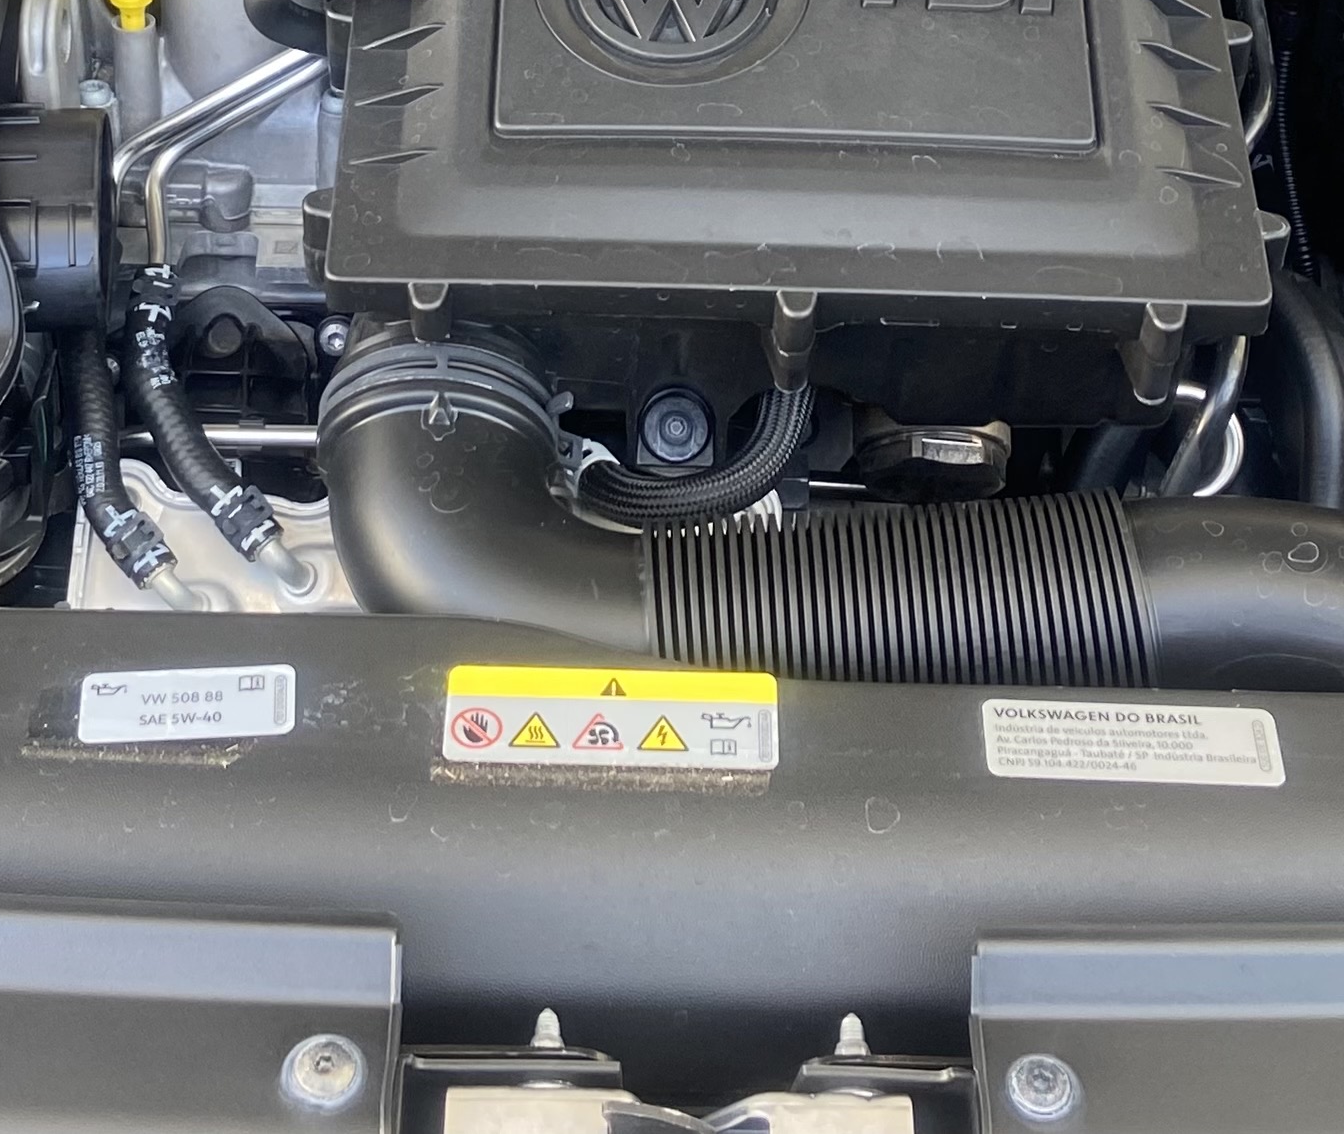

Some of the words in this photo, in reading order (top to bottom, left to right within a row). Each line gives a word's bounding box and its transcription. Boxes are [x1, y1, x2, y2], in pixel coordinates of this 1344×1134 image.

[141, 693, 166, 705] VW
[171, 691, 199, 703] 508
[205, 691, 223, 702] 88
[139, 714, 166, 725] SAE
[171, 712, 222, 724] 5W-40
[994, 708, 1109, 721] VOLKSWAGEN
[1116, 712, 1140, 722] DO
[1146, 713, 1202, 725] BRASIL
[1047, 724, 1059, 734] de
[1110, 727, 1179, 738] automotores
[1014, 735, 1047, 744] Carlos
[1051, 736, 1093, 746] Pedroso
[1097, 738, 1109, 747] da
[1206, 753, 1257, 764] Brasileira
